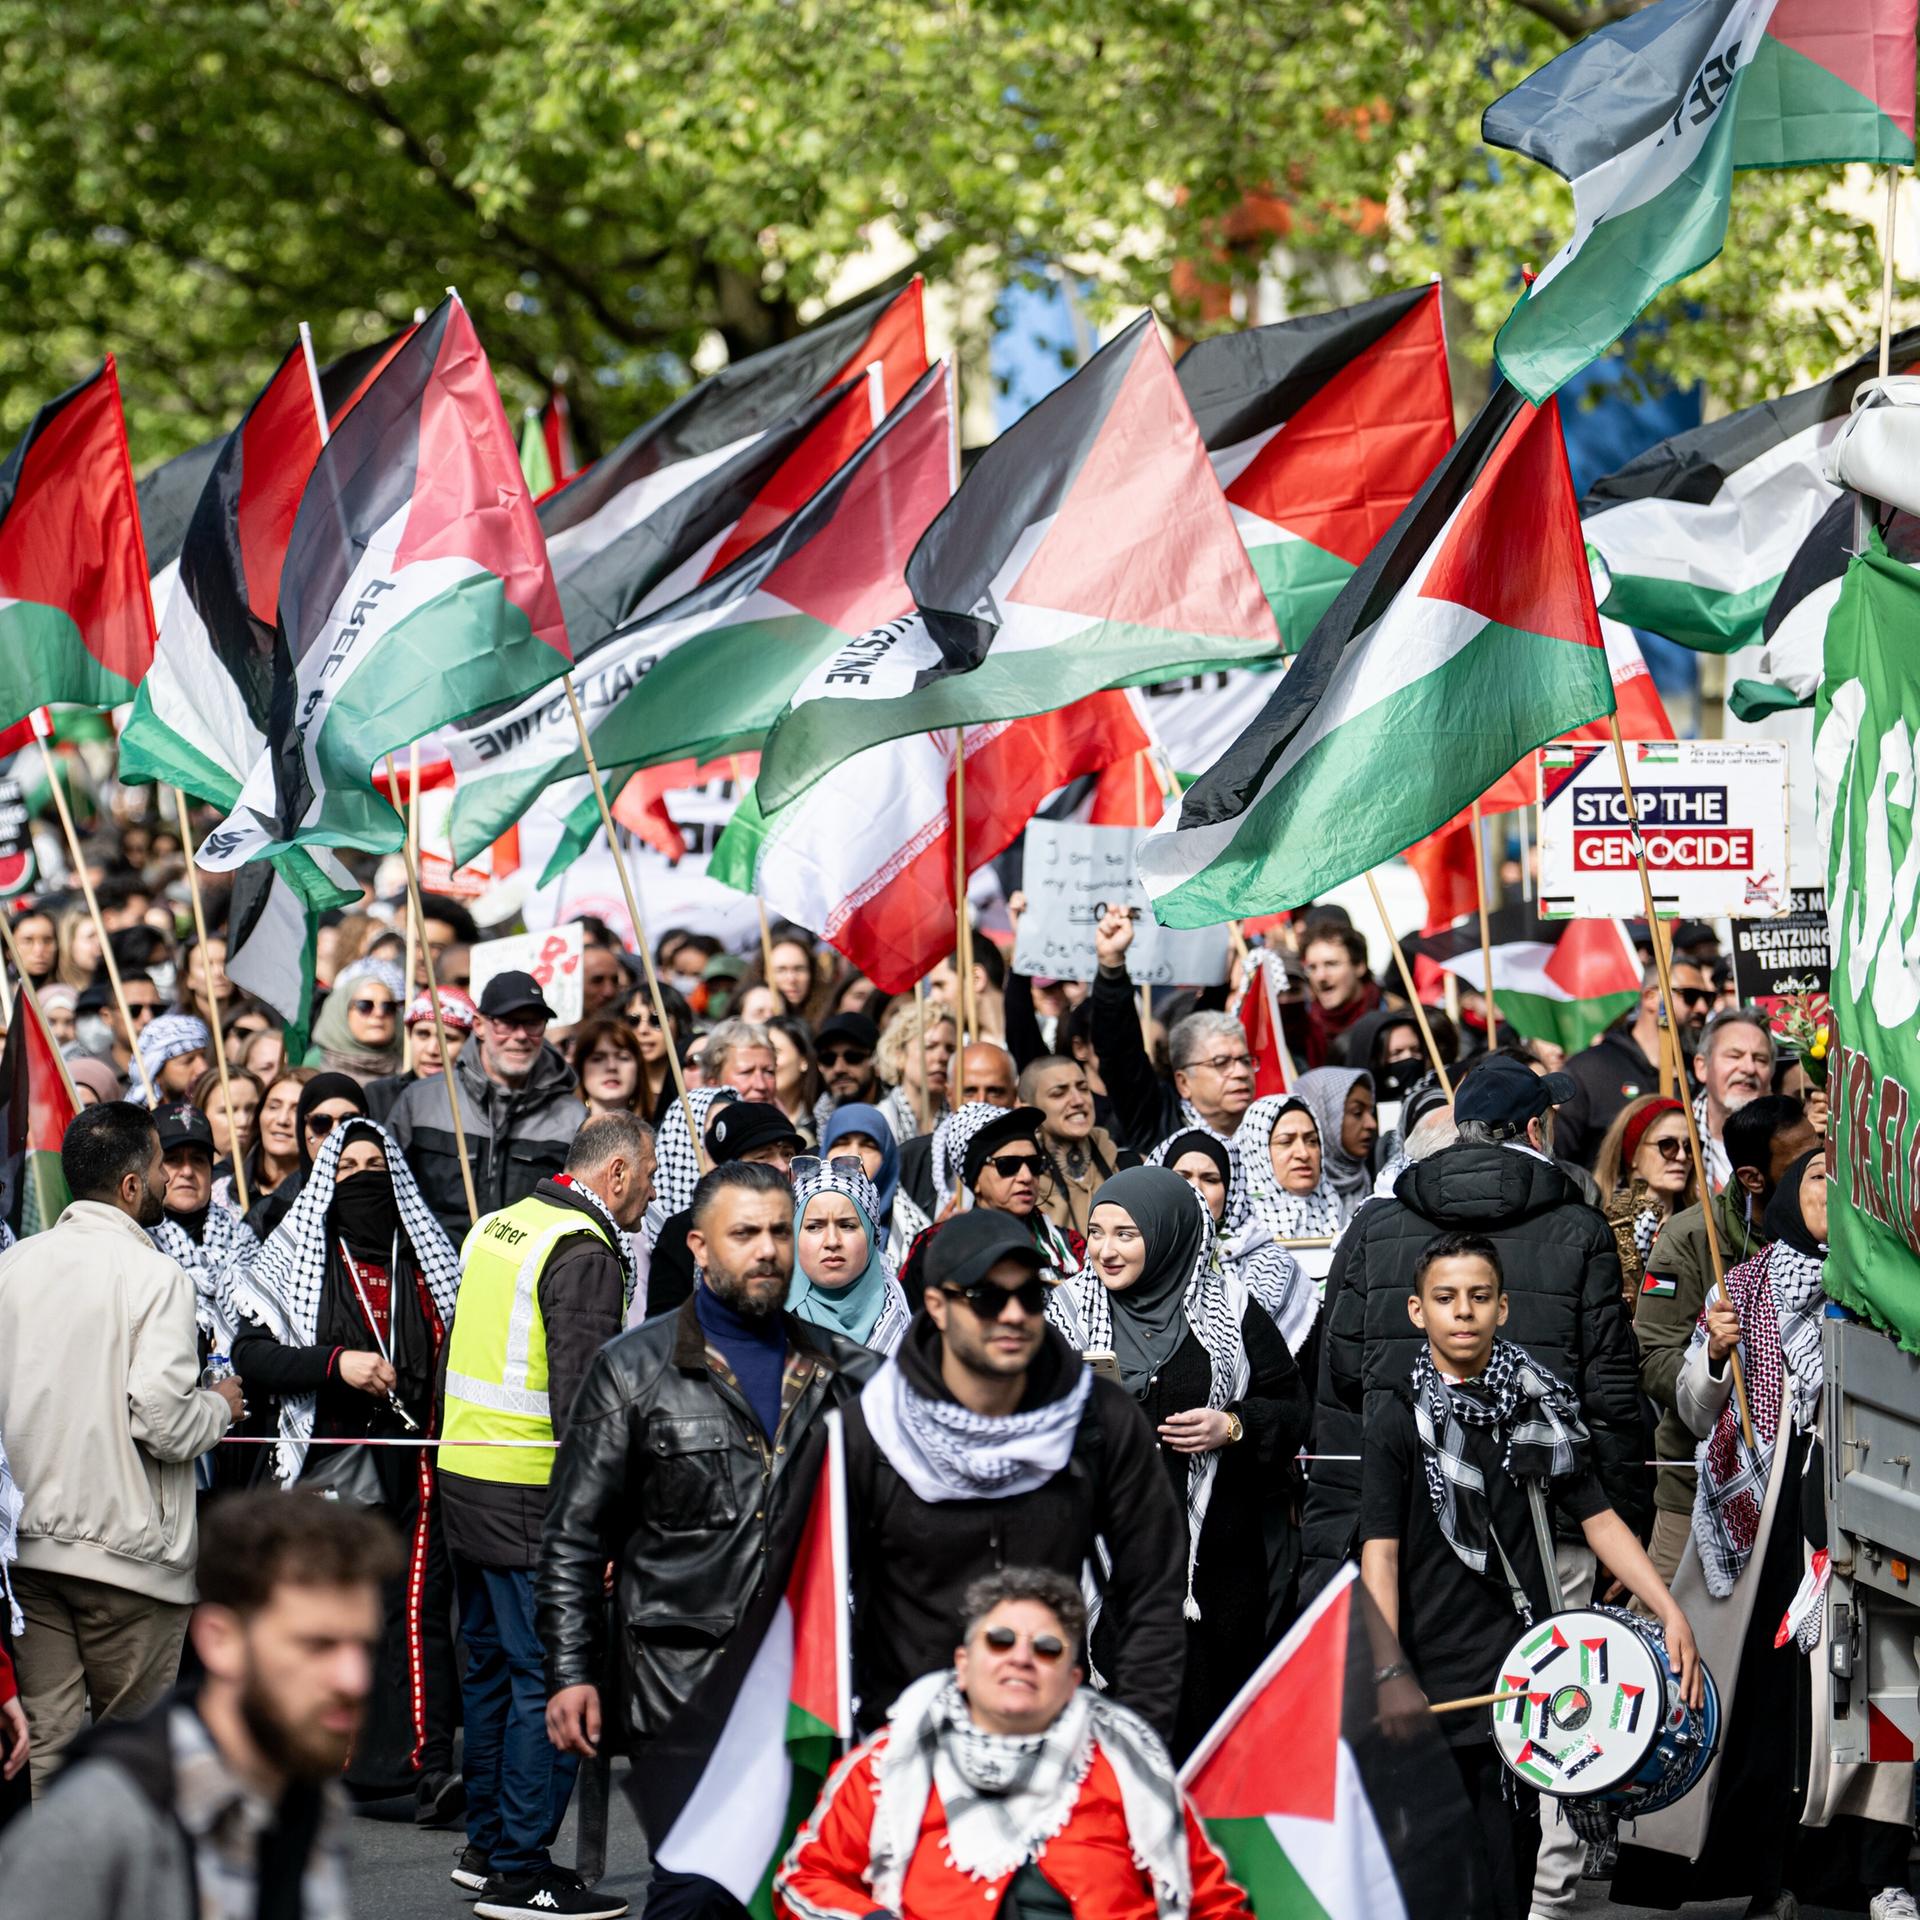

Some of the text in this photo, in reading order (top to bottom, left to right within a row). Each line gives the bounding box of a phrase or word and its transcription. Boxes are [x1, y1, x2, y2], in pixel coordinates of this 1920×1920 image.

[1577, 792, 1722, 822] STOP THE
[1579, 836, 1748, 866] GENOCIDE
[1739, 928, 1830, 951] BESATZUNG
[1757, 947, 1828, 969] TERROR!
